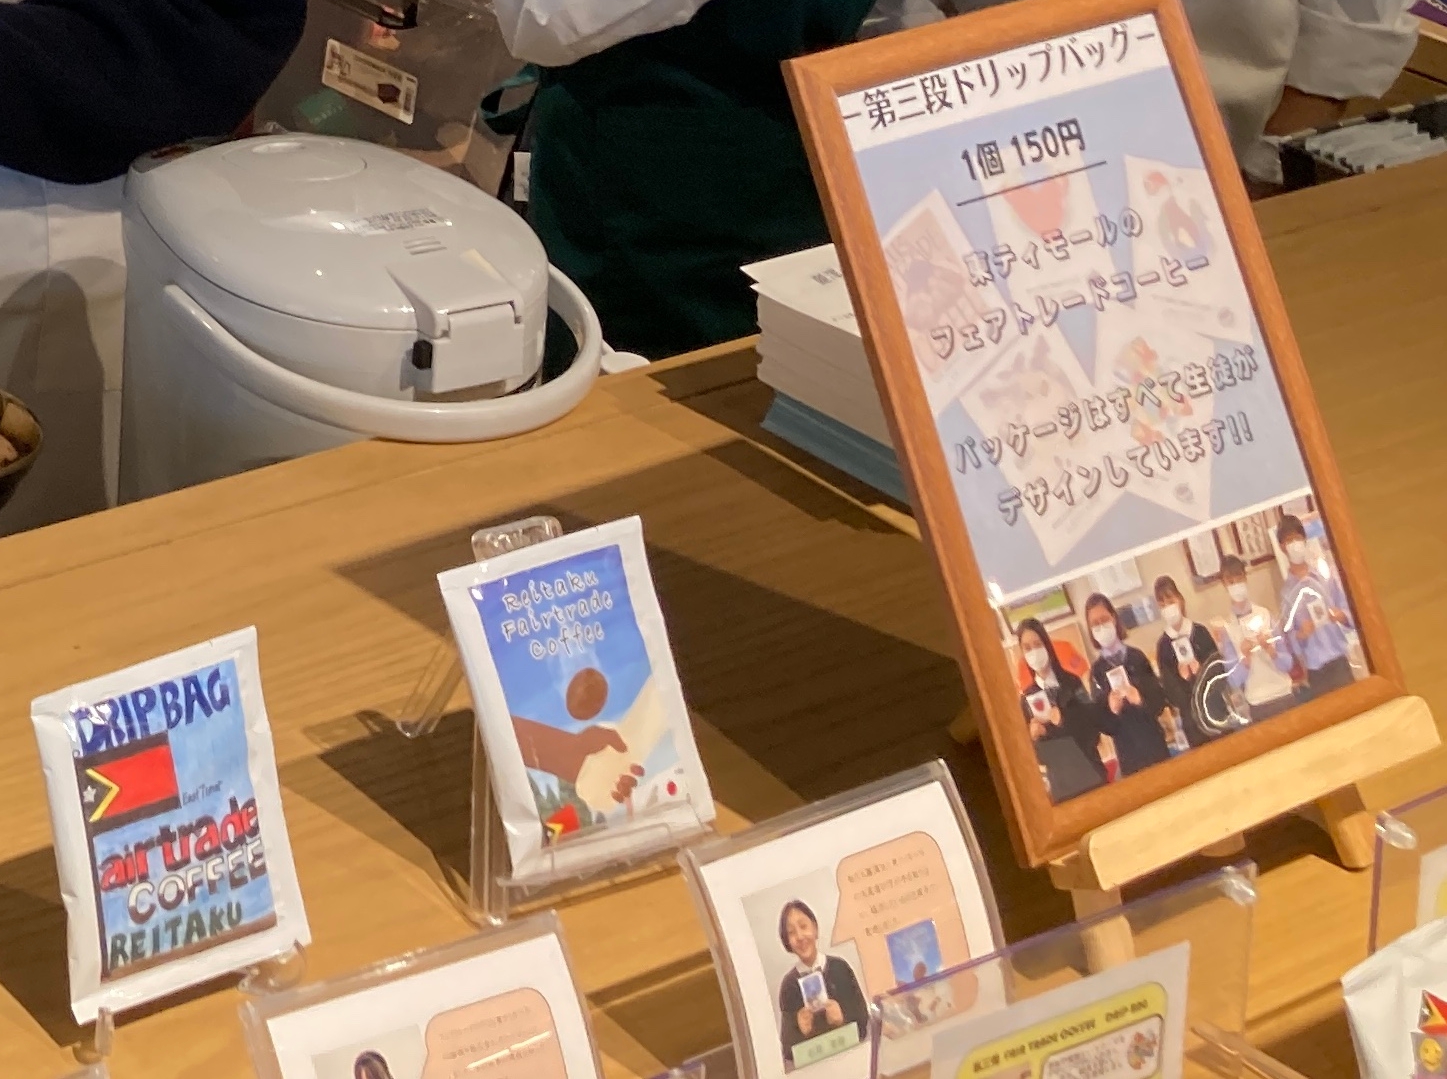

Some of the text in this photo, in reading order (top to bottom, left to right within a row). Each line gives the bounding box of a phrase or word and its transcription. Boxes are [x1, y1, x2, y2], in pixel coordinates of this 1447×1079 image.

[952, 343, 1258, 474] パッケージはすべて生徒が
[501, 591, 614, 642] Fairtrade
[503, 569, 600, 614] Reitaku
[127, 838, 268, 925] COFFEE
